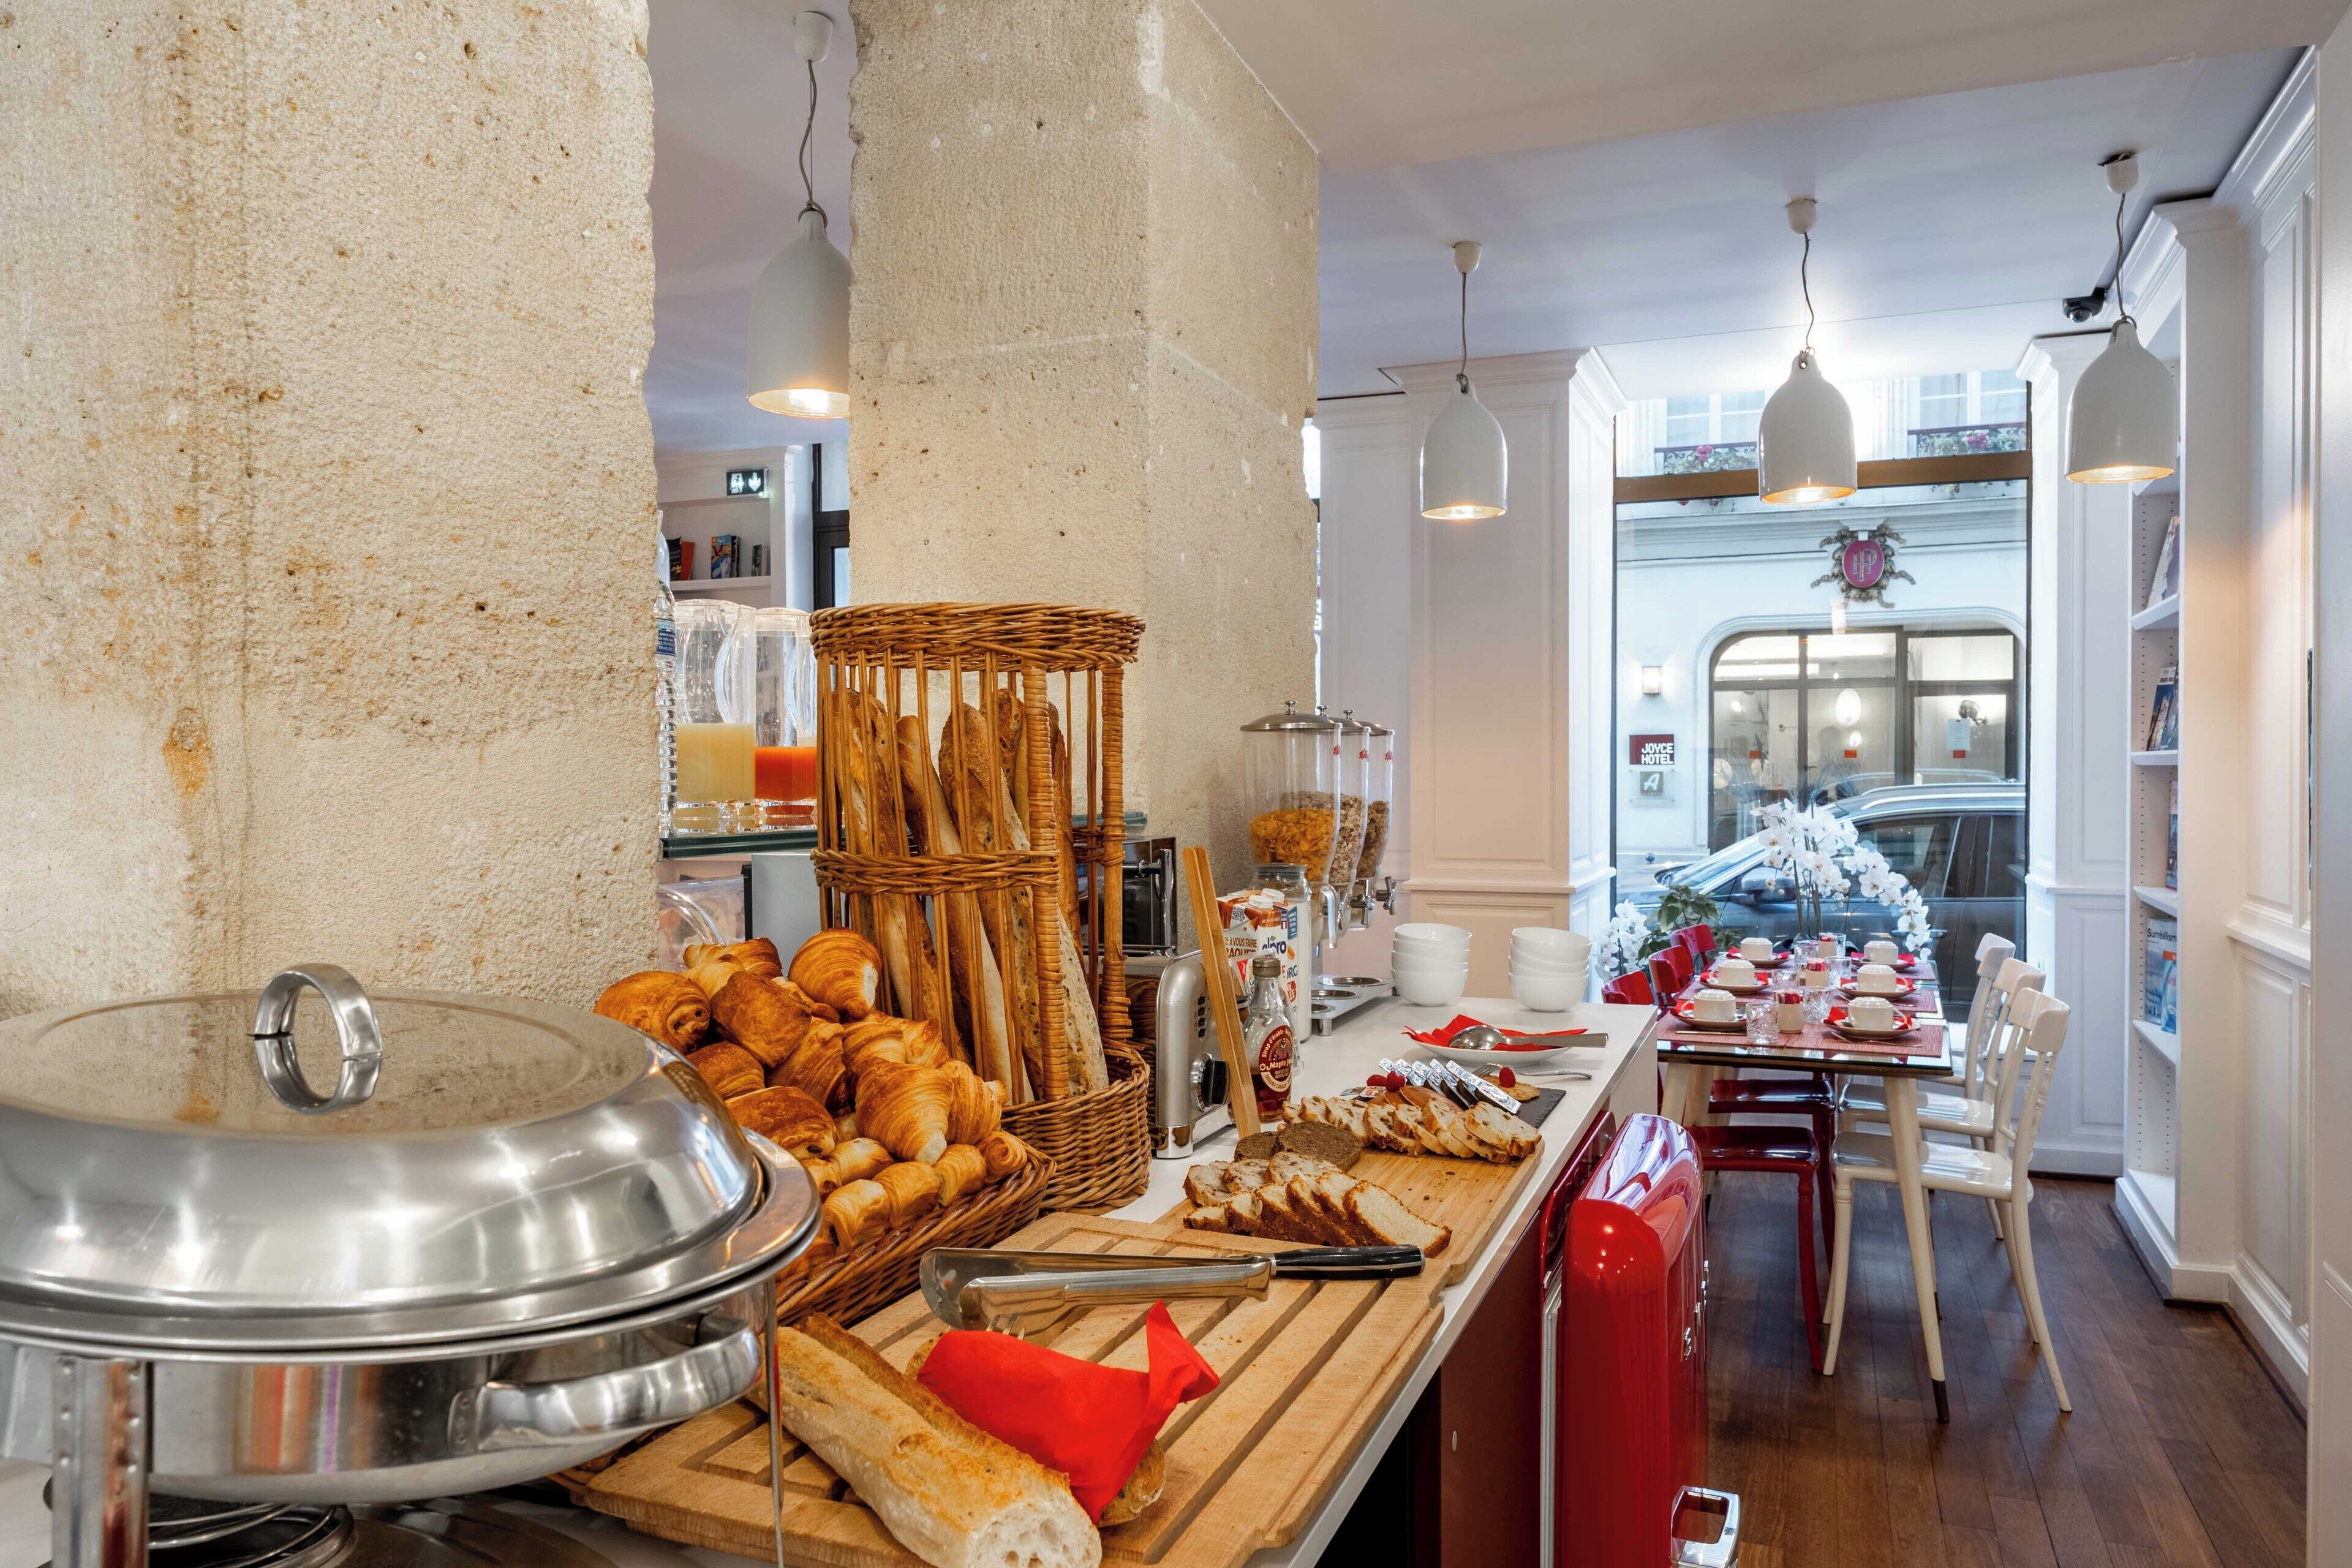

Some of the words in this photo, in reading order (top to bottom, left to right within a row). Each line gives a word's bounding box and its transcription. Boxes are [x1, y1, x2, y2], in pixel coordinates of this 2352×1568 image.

[1642, 742, 1674, 753] JOYCE
[1642, 753, 1674, 764] HOTEL
[1233, 937, 1245, 946] VOUS
[1245, 938, 1257, 948] FAIRE
[1262, 937, 1287, 954] alpro
[1262, 1043, 1271, 1058] Sirop
[1266, 1060, 1286, 1071] Maple
